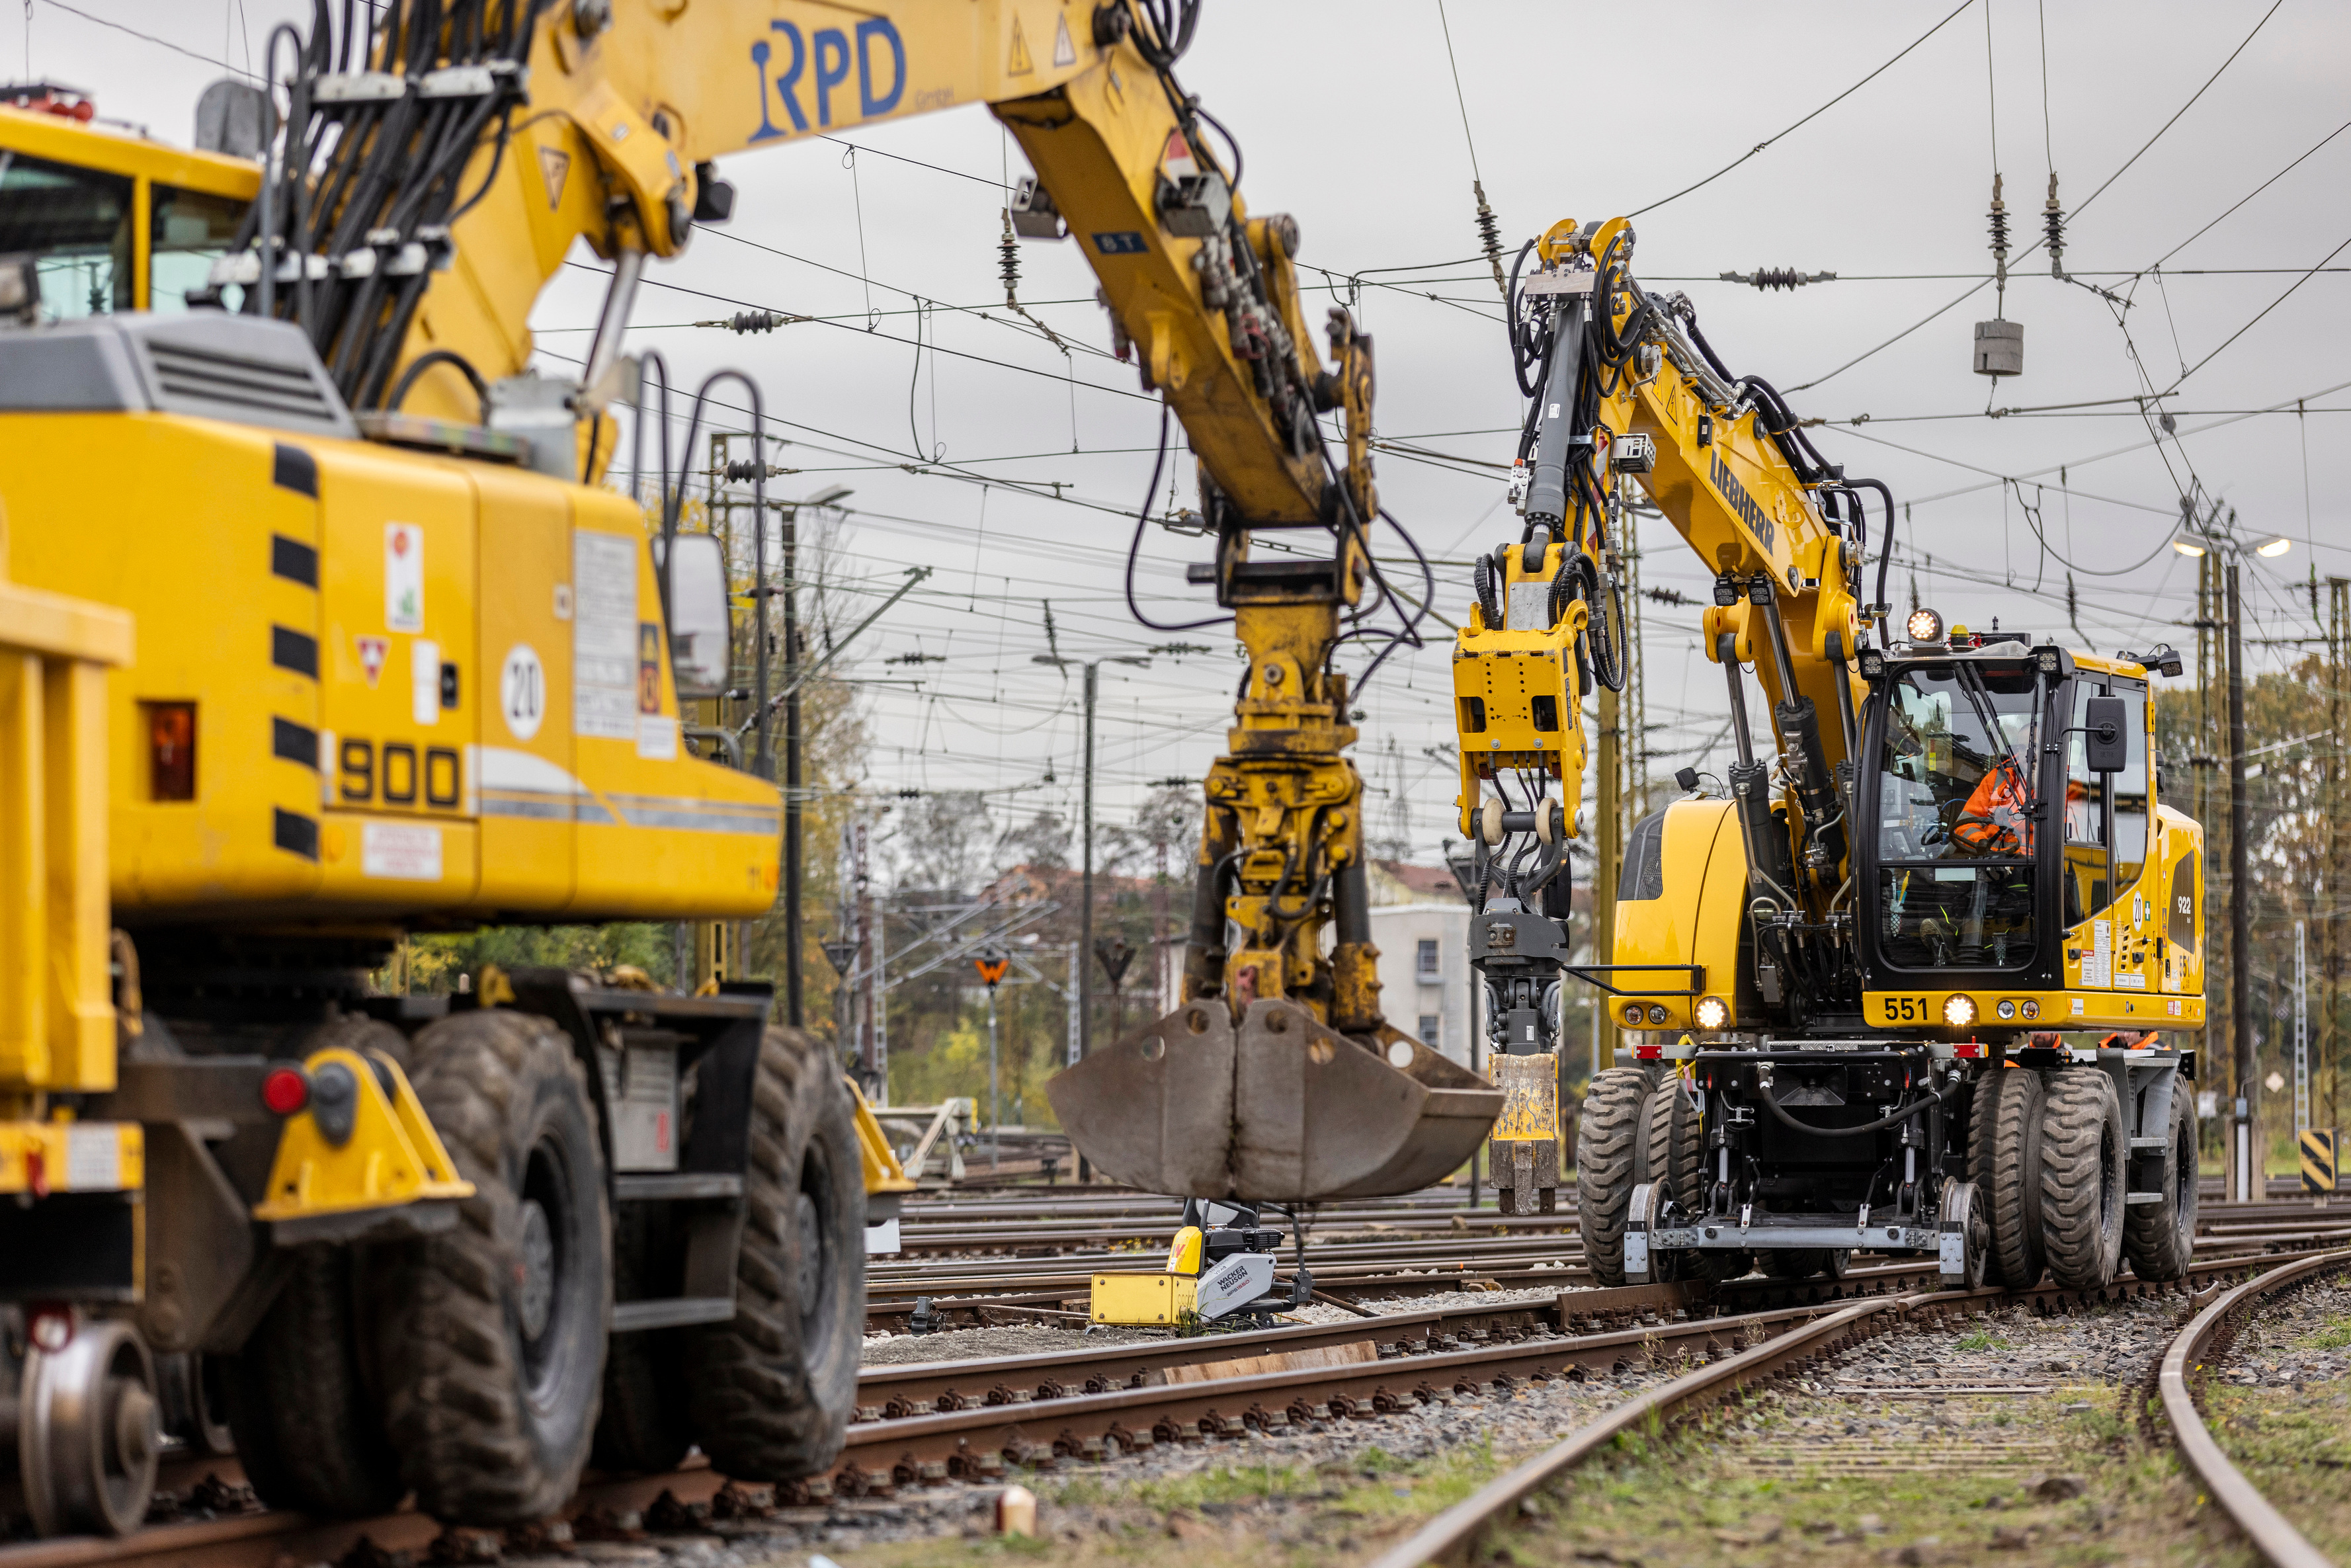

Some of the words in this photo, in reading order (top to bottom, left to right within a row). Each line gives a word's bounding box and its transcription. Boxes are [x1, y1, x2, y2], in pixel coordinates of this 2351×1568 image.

[748, 19, 907, 143] RPD
[1710, 449, 1775, 556] LIEBHERR
[512, 663, 537, 718] 20
[340, 737, 460, 808] 900
[2135, 899, 2141, 923] 20
[2178, 896, 2191, 914] 922
[2179, 956, 2190, 978] 551
[1885, 998, 1928, 1020] 551
[1217, 1265, 1245, 1286] WACKER
[1220, 1270, 1248, 1292] NEUSON
